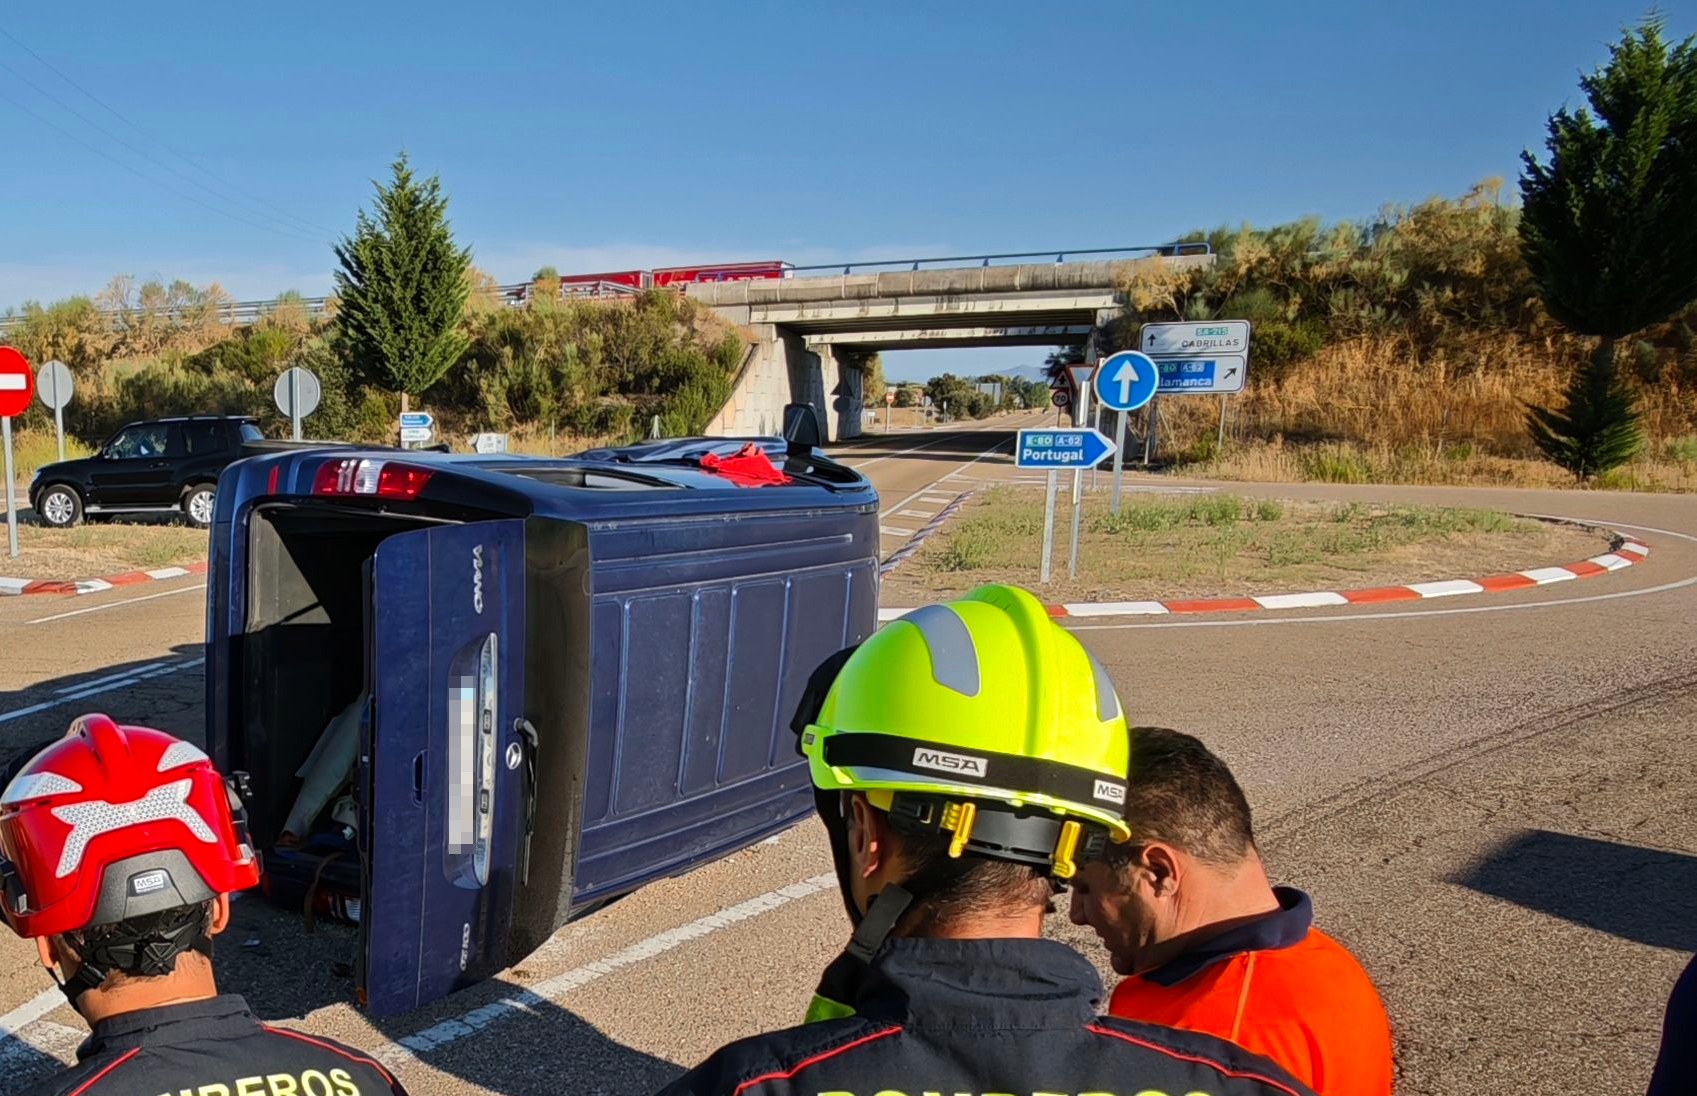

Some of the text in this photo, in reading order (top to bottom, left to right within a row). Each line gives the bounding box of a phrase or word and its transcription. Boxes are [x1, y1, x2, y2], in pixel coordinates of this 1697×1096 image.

[1160, 377, 1211, 387] lamanca
[1057, 436, 1081, 445] A-62
[1023, 448, 1083, 462] Portugal
[472, 544, 483, 615] VIANO
[917, 752, 980, 773] MSA
[136, 876, 161, 888] MSA
